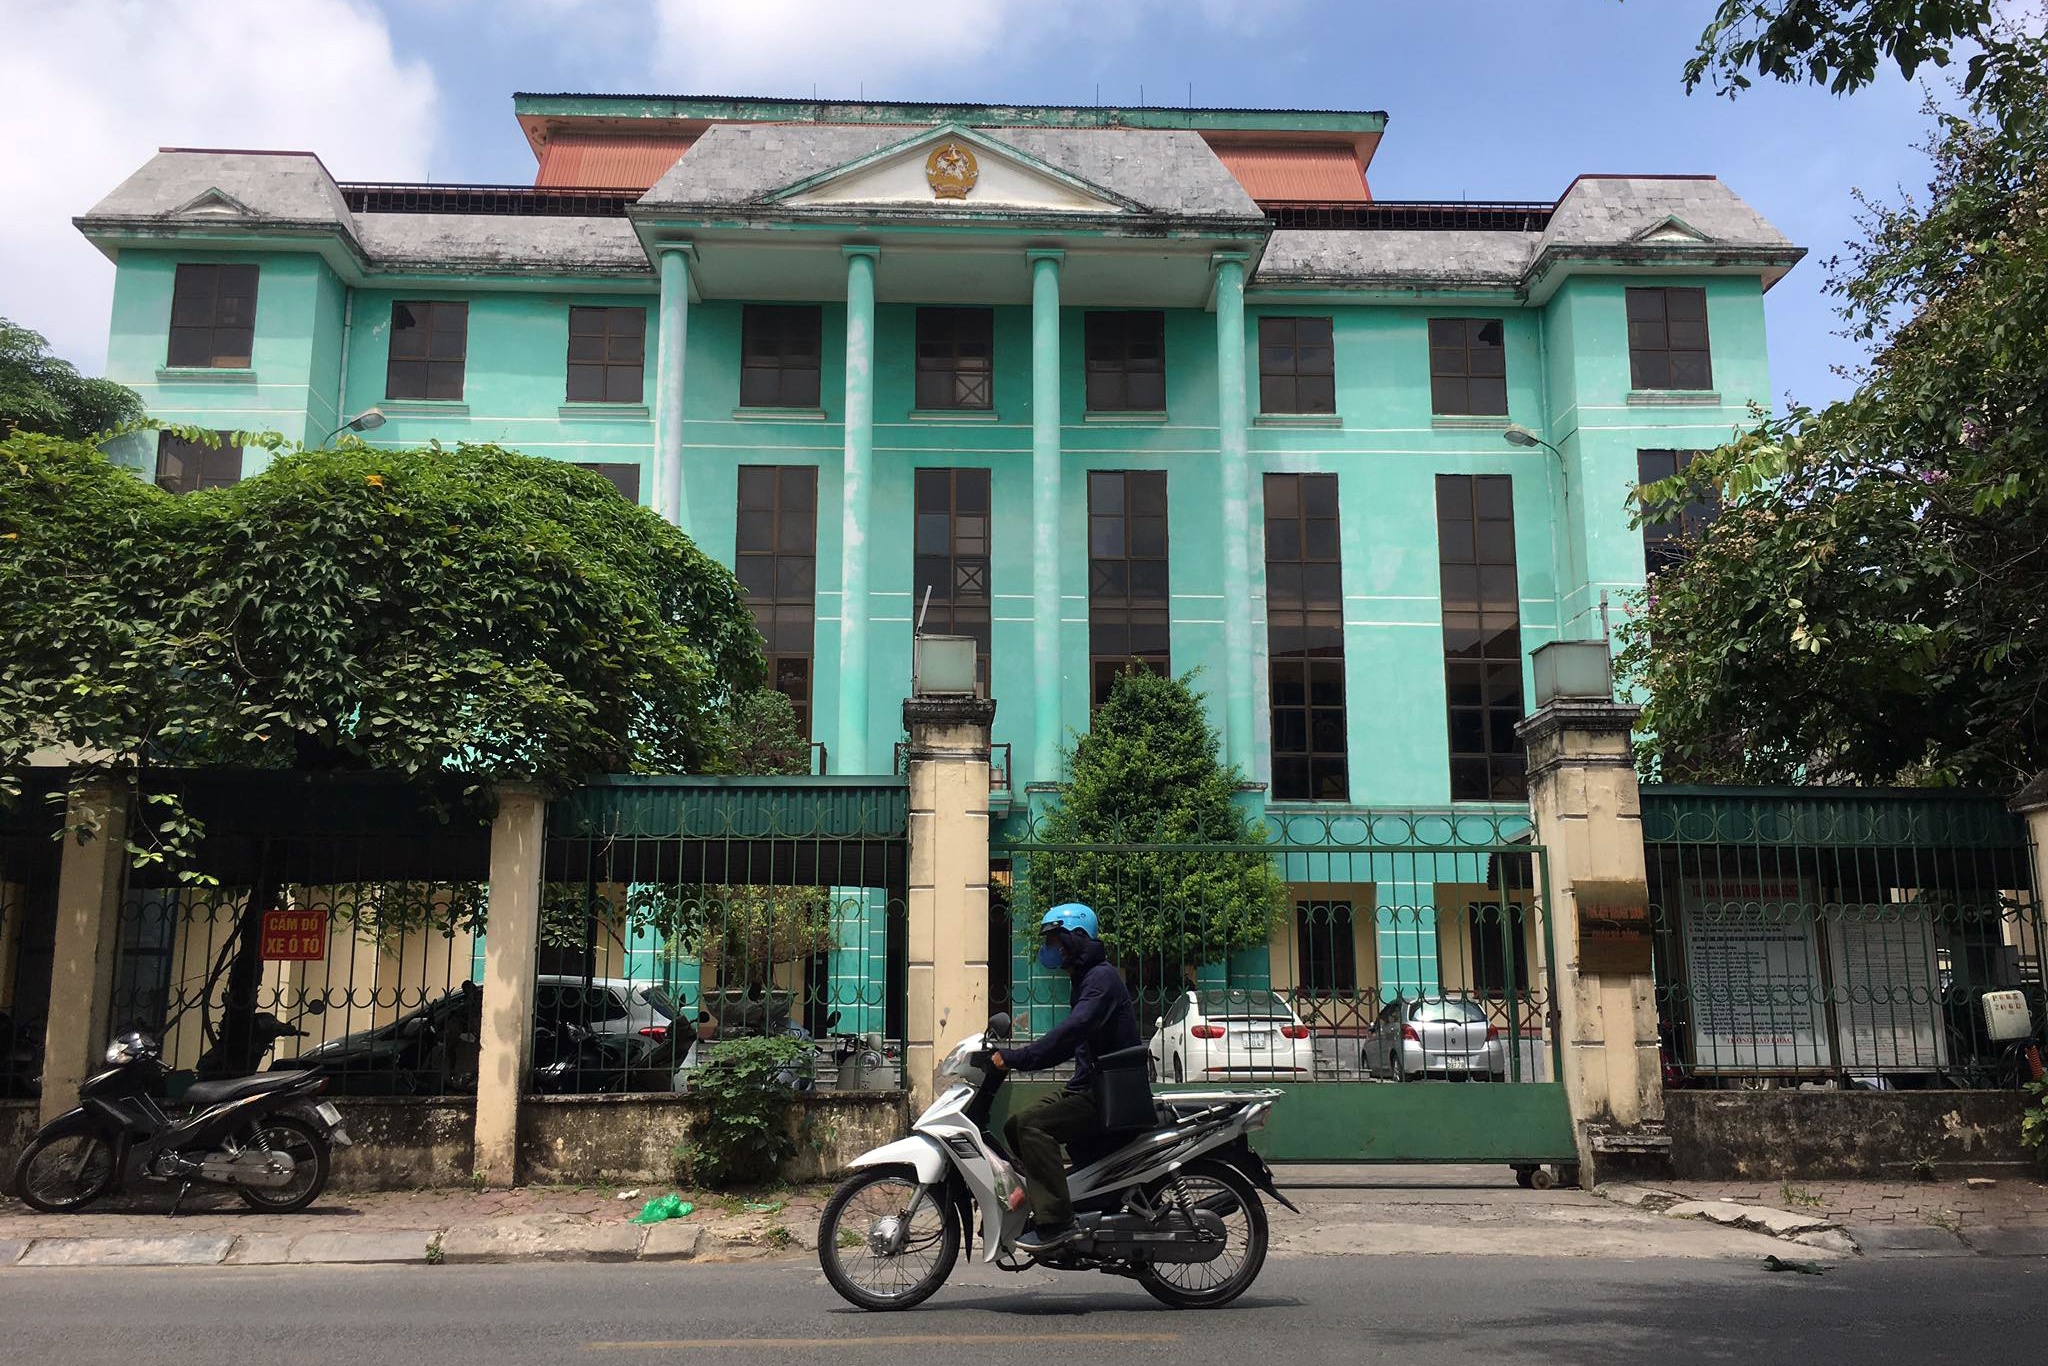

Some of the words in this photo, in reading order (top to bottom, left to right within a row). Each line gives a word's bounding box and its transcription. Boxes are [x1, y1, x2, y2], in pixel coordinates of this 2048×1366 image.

[266, 938, 285, 954] XE
[289, 934, 298, 954] Ô
[302, 934, 320, 954] TÔ
